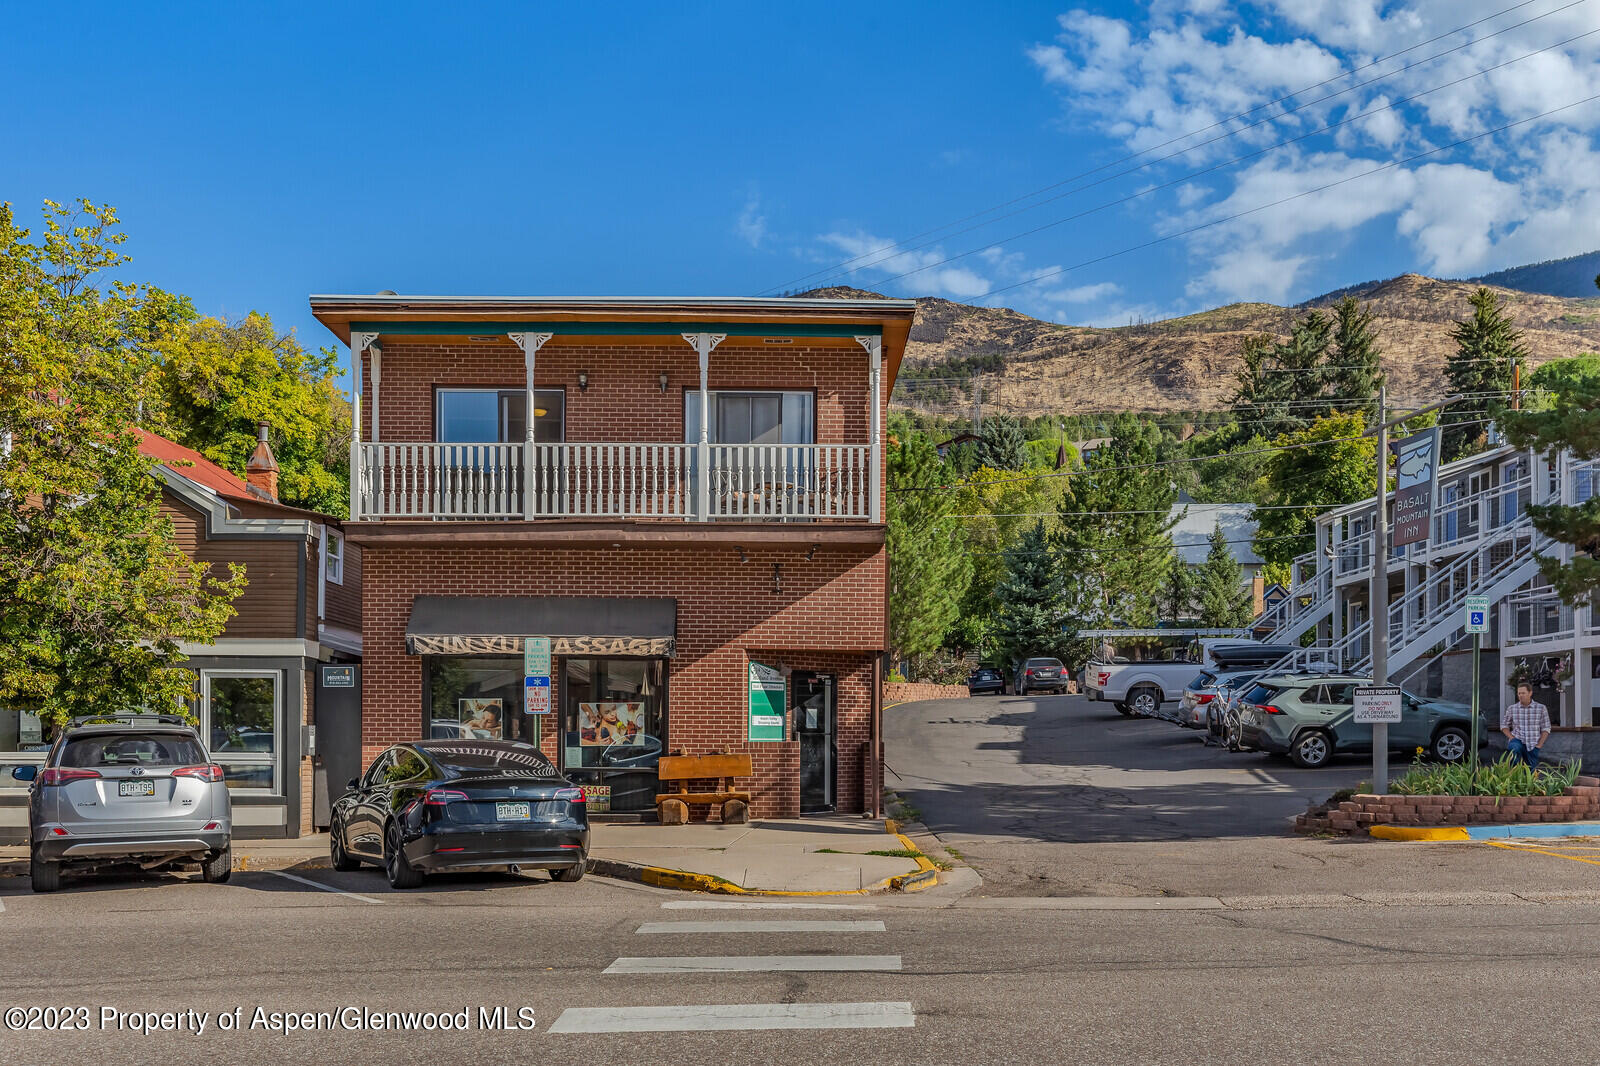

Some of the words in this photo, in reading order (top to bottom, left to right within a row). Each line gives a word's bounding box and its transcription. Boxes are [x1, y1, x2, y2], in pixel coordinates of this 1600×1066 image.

[1397, 492, 1429, 512] BASALT
[1397, 509, 1429, 525] MOUNTAIN
[1404, 525, 1419, 538] INN
[424, 637, 470, 655] XIN
[481, 637, 519, 654] YU
[553, 637, 666, 655] ASSAGE
[582, 786, 610, 796] SSAGE
